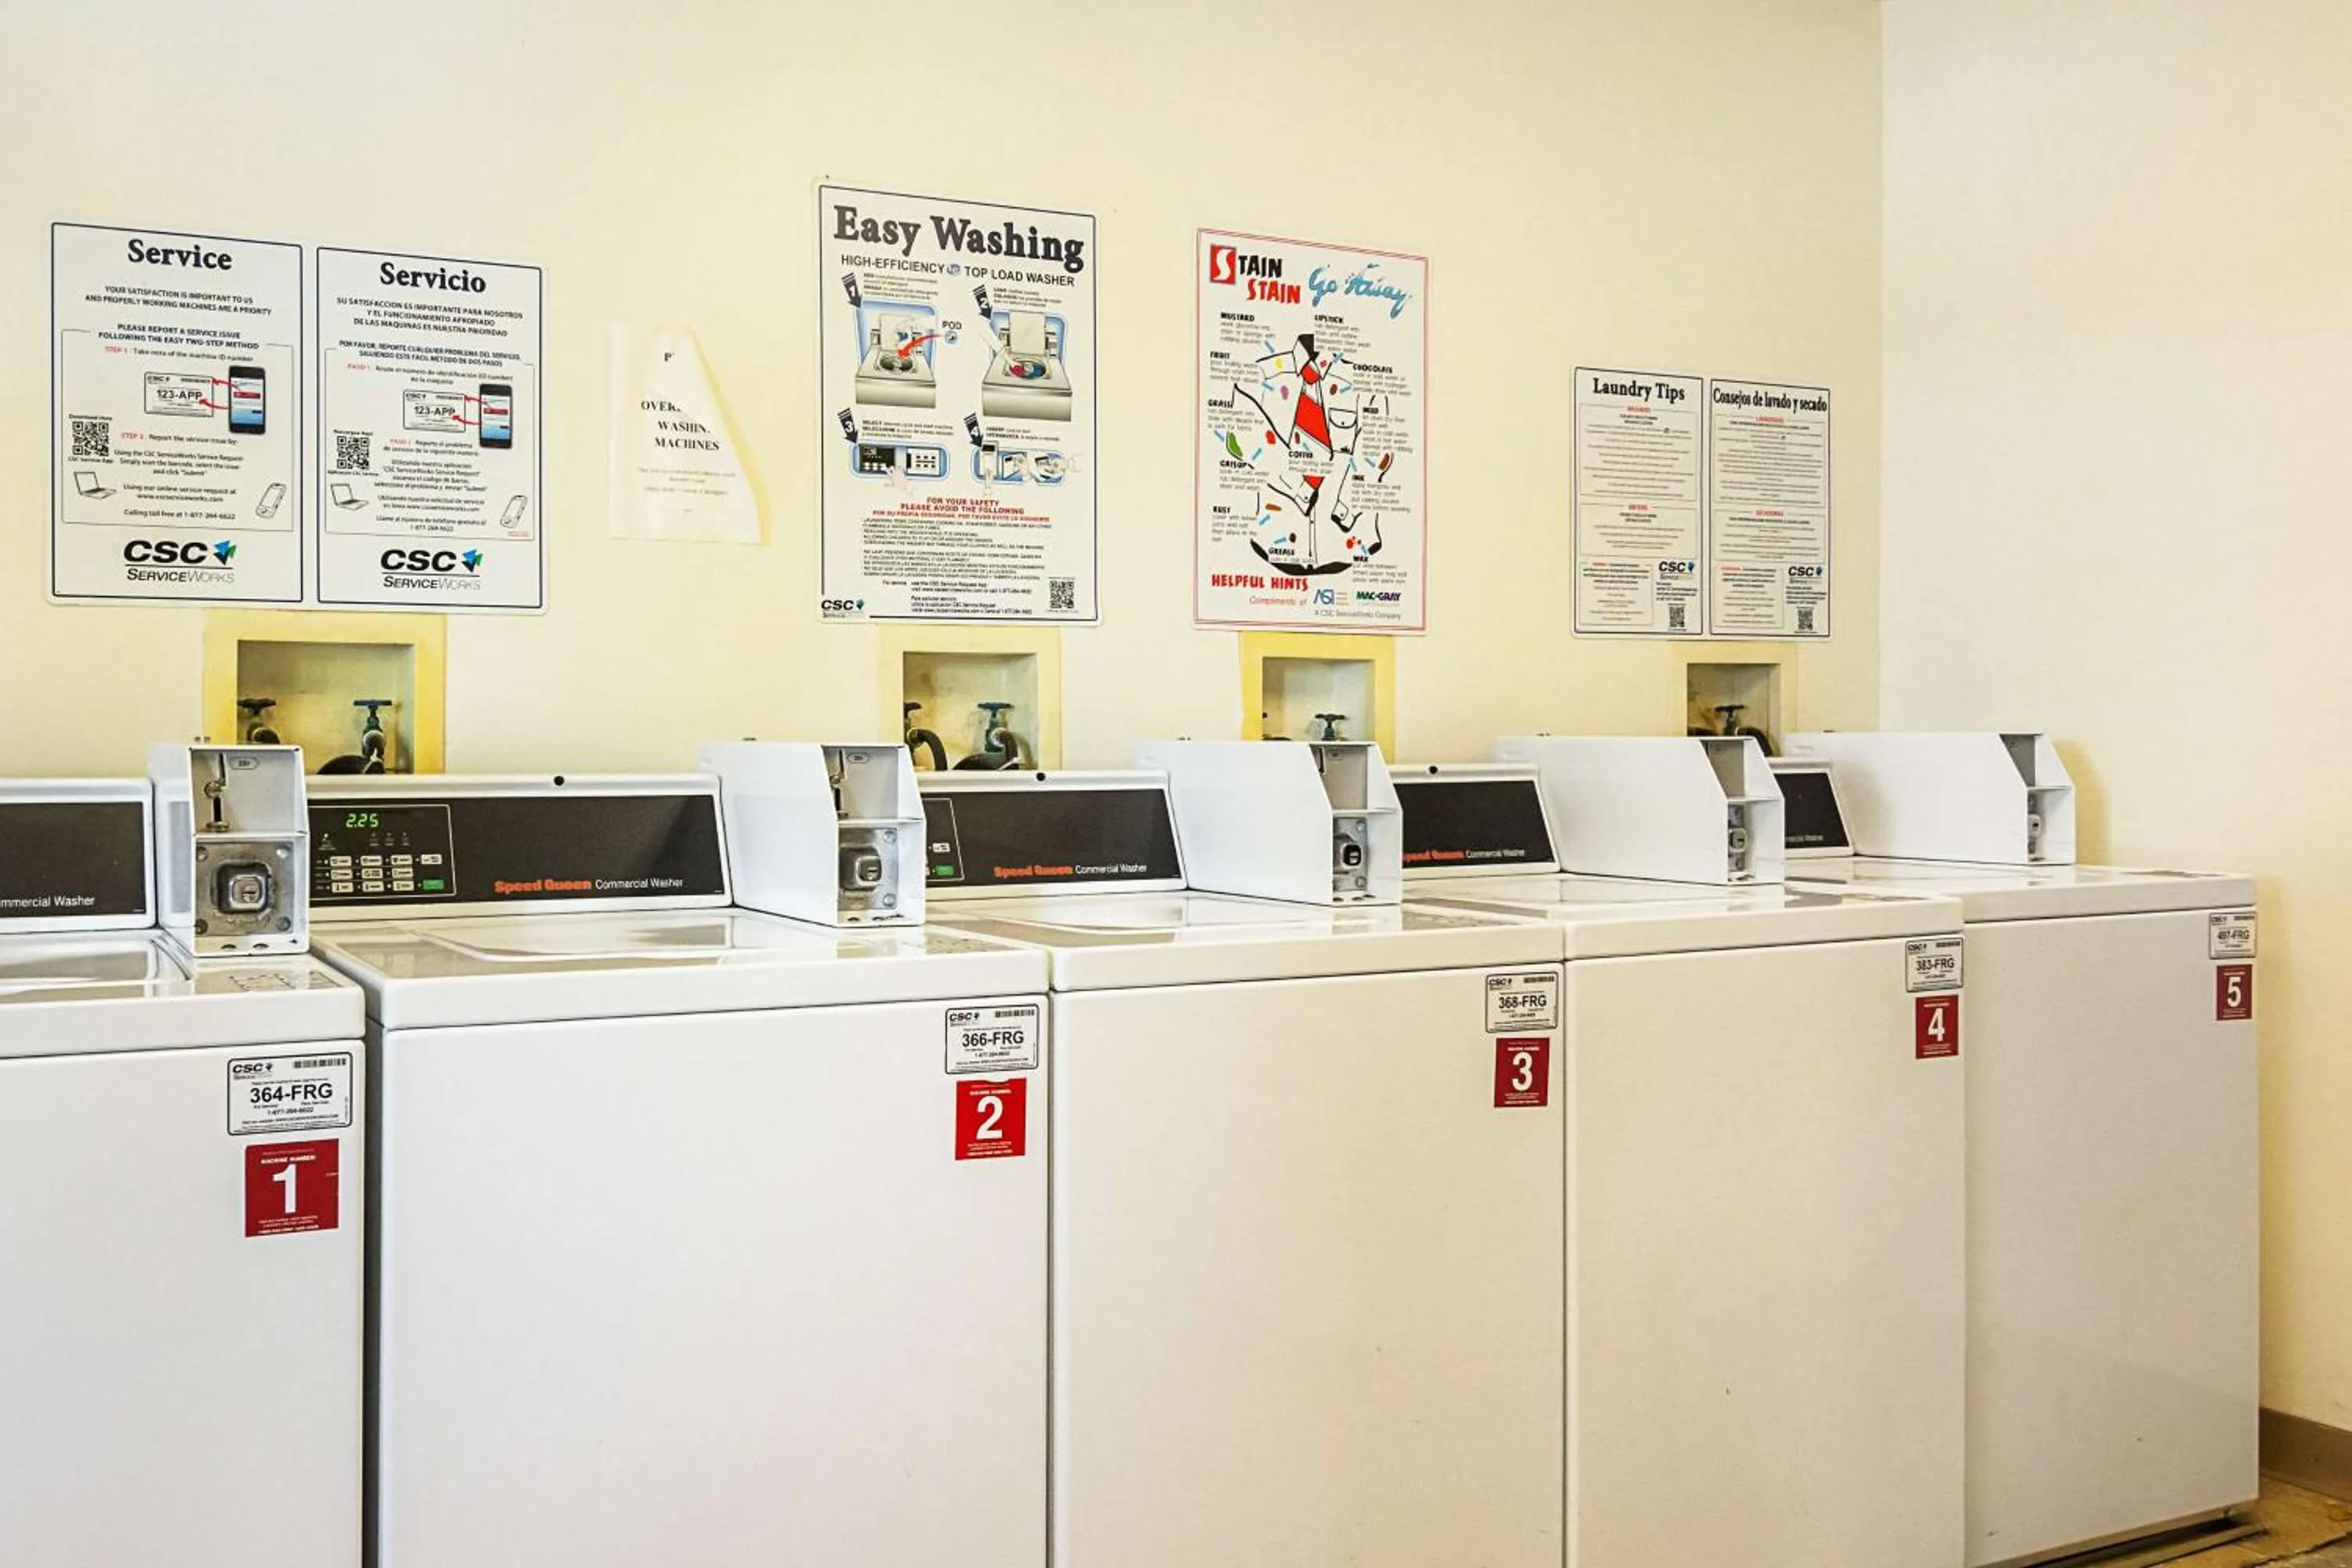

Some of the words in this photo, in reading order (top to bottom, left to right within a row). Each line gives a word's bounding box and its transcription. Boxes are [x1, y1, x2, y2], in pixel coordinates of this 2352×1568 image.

[833, 205, 920, 256] Easy
[931, 215, 1083, 273] Washing
[128, 238, 232, 270] Service
[841, 254, 945, 274] HIGH-EFFICIENCY
[964, 267, 988, 278] TOP
[991, 269, 1022, 281] LOAD
[1025, 273, 1075, 287] WASHER
[1212, 248, 1283, 281] STAIN
[379, 261, 486, 293] Servicio
[105, 285, 125, 294] YOUR
[128, 288, 179, 298] SATISFACTION
[190, 292, 230, 303] IMPORTANT
[1247, 278, 1301, 304] STAIN
[1308, 267, 1338, 307] Go
[103, 296, 140, 305] PROPERLY
[143, 299, 177, 308] WORKING
[179, 302, 216, 311] MACHINES
[240, 306, 271, 315] PRIORITY
[350, 298, 403, 309] SATISFACCION
[414, 303, 461, 314] IMPORTANTE
[980, 298, 988, 308] 2
[384, 310, 450, 321] FUNCIONAMIENTO
[452, 317, 495, 326] APROPIADO
[1221, 312, 1254, 321] MUSTARD
[118, 323, 146, 332] PLEASE
[148, 325, 177, 334] REPORT
[187, 328, 217, 337] SERVICE
[381, 320, 422, 329] MAQUINAS
[433, 325, 466, 333] NUESTRA
[468, 328, 508, 336] PRIORIDAD
[942, 321, 962, 330] POD
[99, 332, 146, 341] FOLLOWING
[187, 338, 224, 347] TWO-STEP
[226, 341, 259, 350] METHOD
[379, 343, 406, 351] REPORTE
[408, 345, 444, 354] CUALQUIER
[445, 348, 478, 358] PROBLEMA
[1353, 364, 1392, 373] CHOCOLATE
[157, 389, 202, 400] 123-APP
[1593, 378, 1651, 401] Laundry
[1656, 383, 1685, 404] Tips
[1208, 399, 1232, 408] GRASS
[1713, 387, 1751, 409] Consejos
[1753, 390, 1762, 406] de
[1765, 392, 1791, 408] lavado
[1794, 398, 1798, 414] y
[1800, 397, 1827, 412] secado
[414, 406, 456, 416] 123-APP
[658, 420, 710, 434] WASHIN
[847, 422, 853, 432] 3
[971, 426, 978, 436] 4
[655, 437, 720, 451] MACHINES
[1220, 460, 1247, 469] CATSUP
[124, 539, 209, 564] CSC
[380, 549, 456, 572] CSC
[1659, 561, 1686, 572] CSC
[1788, 566, 1814, 575] CSC
[1212, 574, 1265, 588] HELPFUL
[1271, 577, 1308, 591] HINTS
[1250, 596, 1296, 605] Compliments
[1356, 591, 1401, 601] MAC-GRAY
[822, 600, 853, 610] CSC
[346, 813, 379, 828] 2.25
[994, 866, 1033, 878] Speed
[1035, 865, 1073, 875] Queen
[1075, 864, 1118, 874] Commercial
[1120, 864, 1147, 873] Washer
[494, 879, 543, 894] Speed
[544, 878, 591, 891] Queen
[595, 878, 648, 890] Commercial
[651, 877, 683, 887] Washer
[53, 895, 95, 906] Washer
[1916, 958, 1955, 971] 383-FRG
[2227, 976, 2241, 1007] 5
[1498, 994, 1547, 1008] 368-FRG
[949, 1012, 972, 1022] CSC
[1928, 1007, 1945, 1042] 4
[962, 1030, 1024, 1047] 366-FRG
[232, 1063, 263, 1073] CSC
[1512, 1051, 1533, 1091] 3
[250, 1083, 333, 1104] 364-FRG
[976, 1095, 1004, 1140] 2
[273, 1163, 296, 1214] 1
